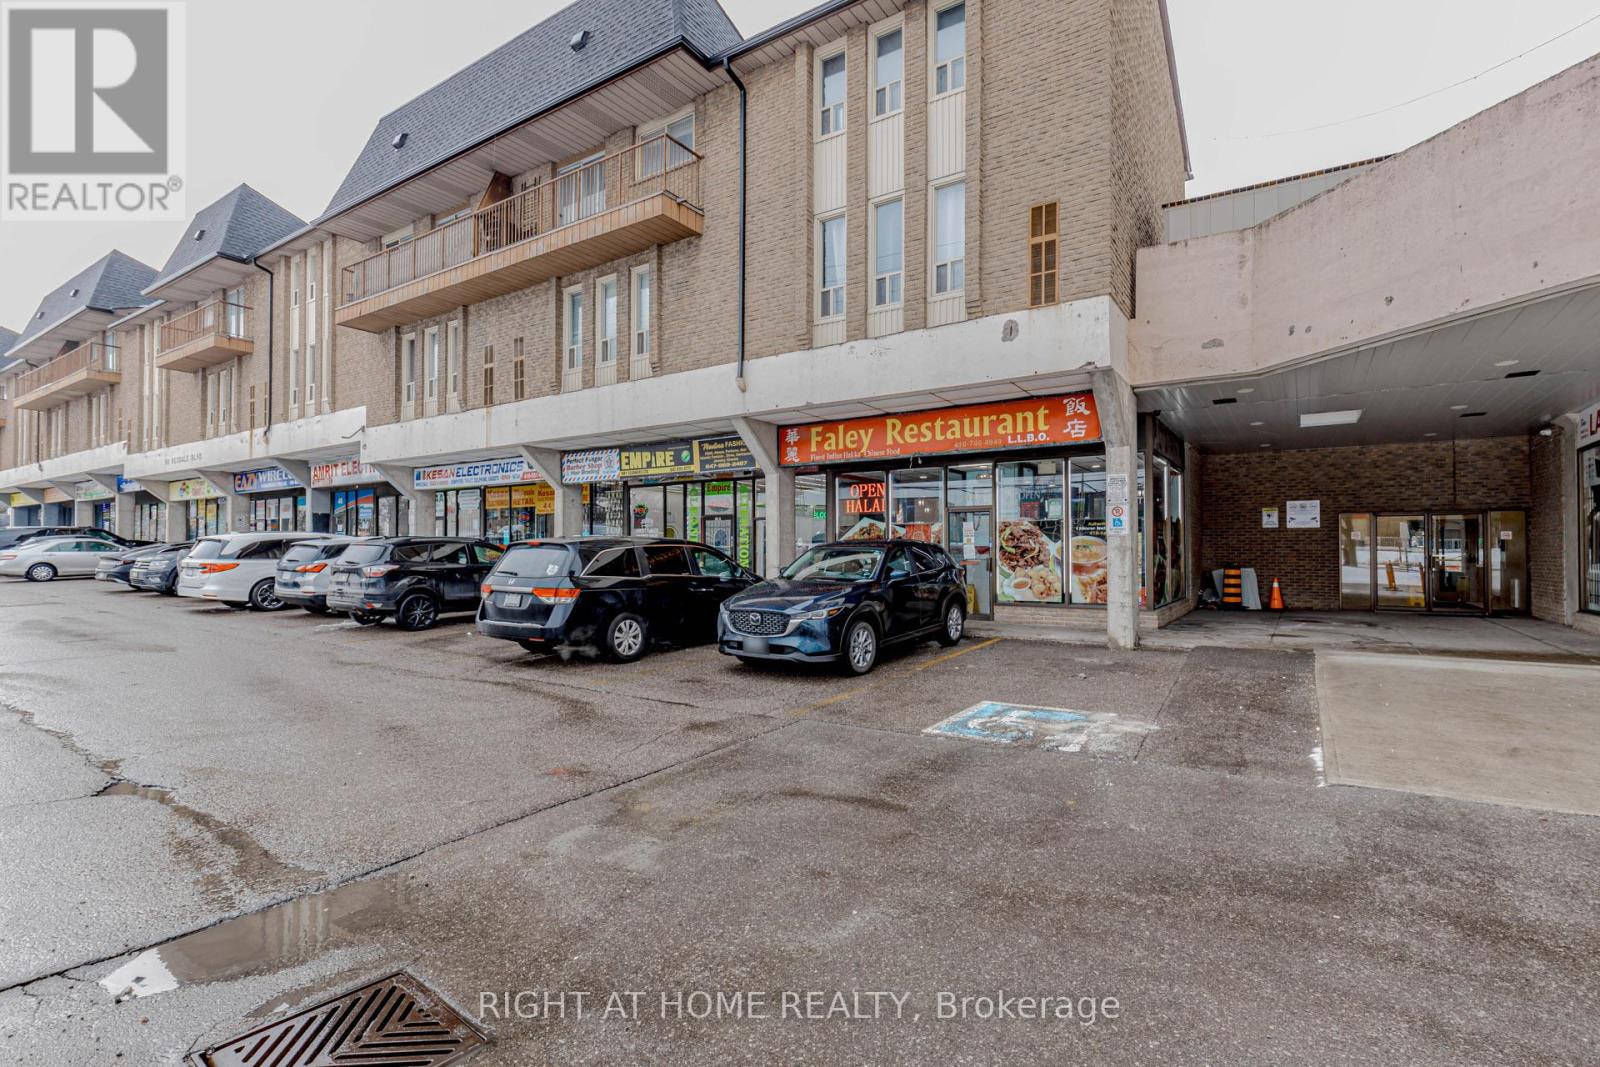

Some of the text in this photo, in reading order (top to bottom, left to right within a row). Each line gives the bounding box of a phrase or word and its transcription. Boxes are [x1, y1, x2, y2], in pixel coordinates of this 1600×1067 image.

[1063, 396, 1091, 438] 飯店
[810, 405, 1050, 453] Faley Restaurant
[1007, 432, 1050, 444] L.L.B.O.
[313, 463, 339, 480] AMRIT
[456, 461, 524, 478] ELECTRONICS
[706, 483, 731, 494] Empire
[850, 484, 885, 498] OPEN
